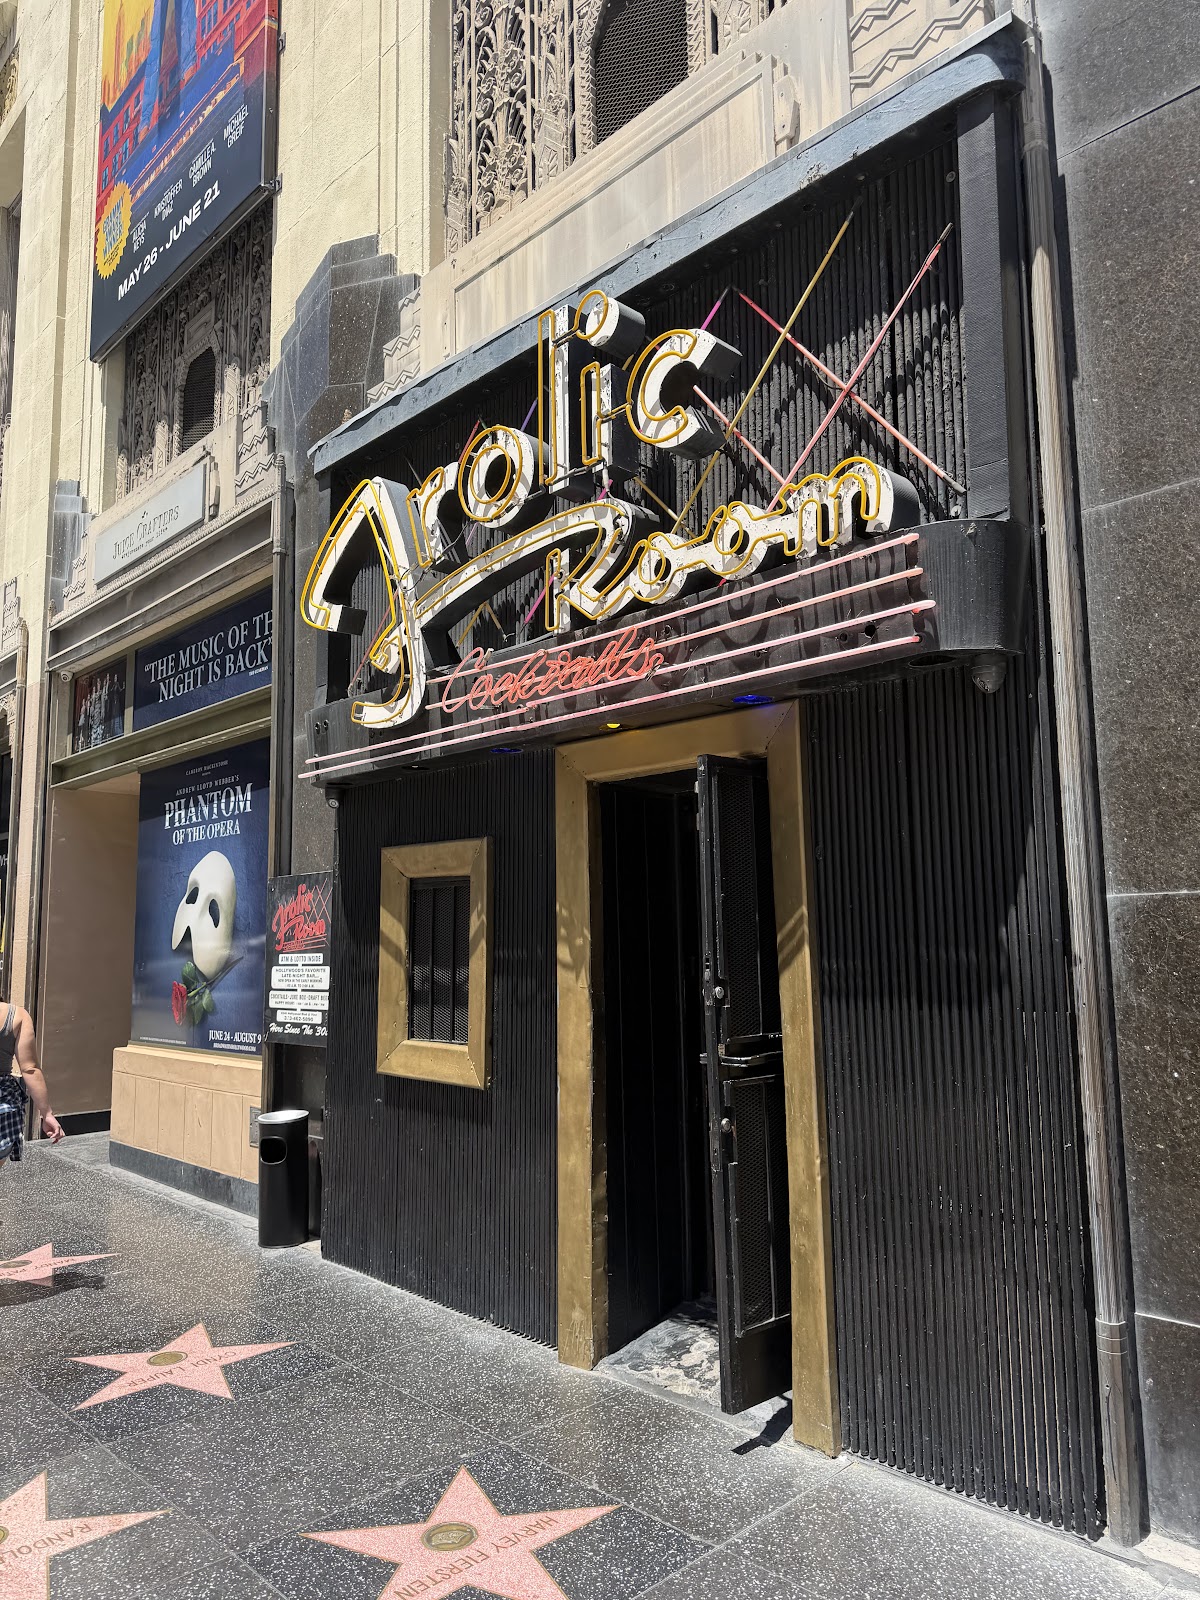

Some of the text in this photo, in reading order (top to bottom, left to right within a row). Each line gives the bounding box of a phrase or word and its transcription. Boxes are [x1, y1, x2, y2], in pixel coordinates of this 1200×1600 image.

[223, 105, 249, 141] MICHAEL
[227, 121, 244, 148] GREIF
[189, 147, 212, 179] CAMILLE
[192, 157, 212, 187] BROWN
[154, 178, 183, 218] KRISTOFFER
[162, 202, 174, 221] DIAZ
[118, 262, 142, 301] MAY
[143, 246, 158, 274] 26
[165, 199, 201, 249] JUNE
[203, 180, 220, 210] 21
[132, 219, 147, 243] ALICIA
[133, 232, 145, 253] KEYS
[300, 289, 738, 729] Frolic
[113, 532, 135, 560] JUICE
[136, 505, 180, 541] CRAFTERS
[414, 456, 905, 636] Room
[178, 632, 224, 671] MUSIC
[228, 620, 249, 649] OF
[253, 609, 273, 640] TH
[158, 666, 205, 703] NIGHT
[207, 661, 221, 685] IS
[441, 626, 664, 713] Cocktails
[164, 782, 253, 830] PHANTOM
[176, 786, 195, 796] ANDREW
[196, 781, 213, 791] LLOYD
[172, 818, 241, 846] OF THE OPERA
[208, 1029, 223, 1041] JUNE
[223, 1031, 230, 1041] 24
[233, 1032, 257, 1043] AUGUST
[257, 1034, 261, 1044] 9
[269, 1022, 283, 1033] Here
[284, 1023, 300, 1034] Since
[302, 1024, 314, 1035] The
[126, 1351, 237, 1388] CYNDI LAUPER
[393, 1515, 558, 1600] HARVEY FIERSTEIN
